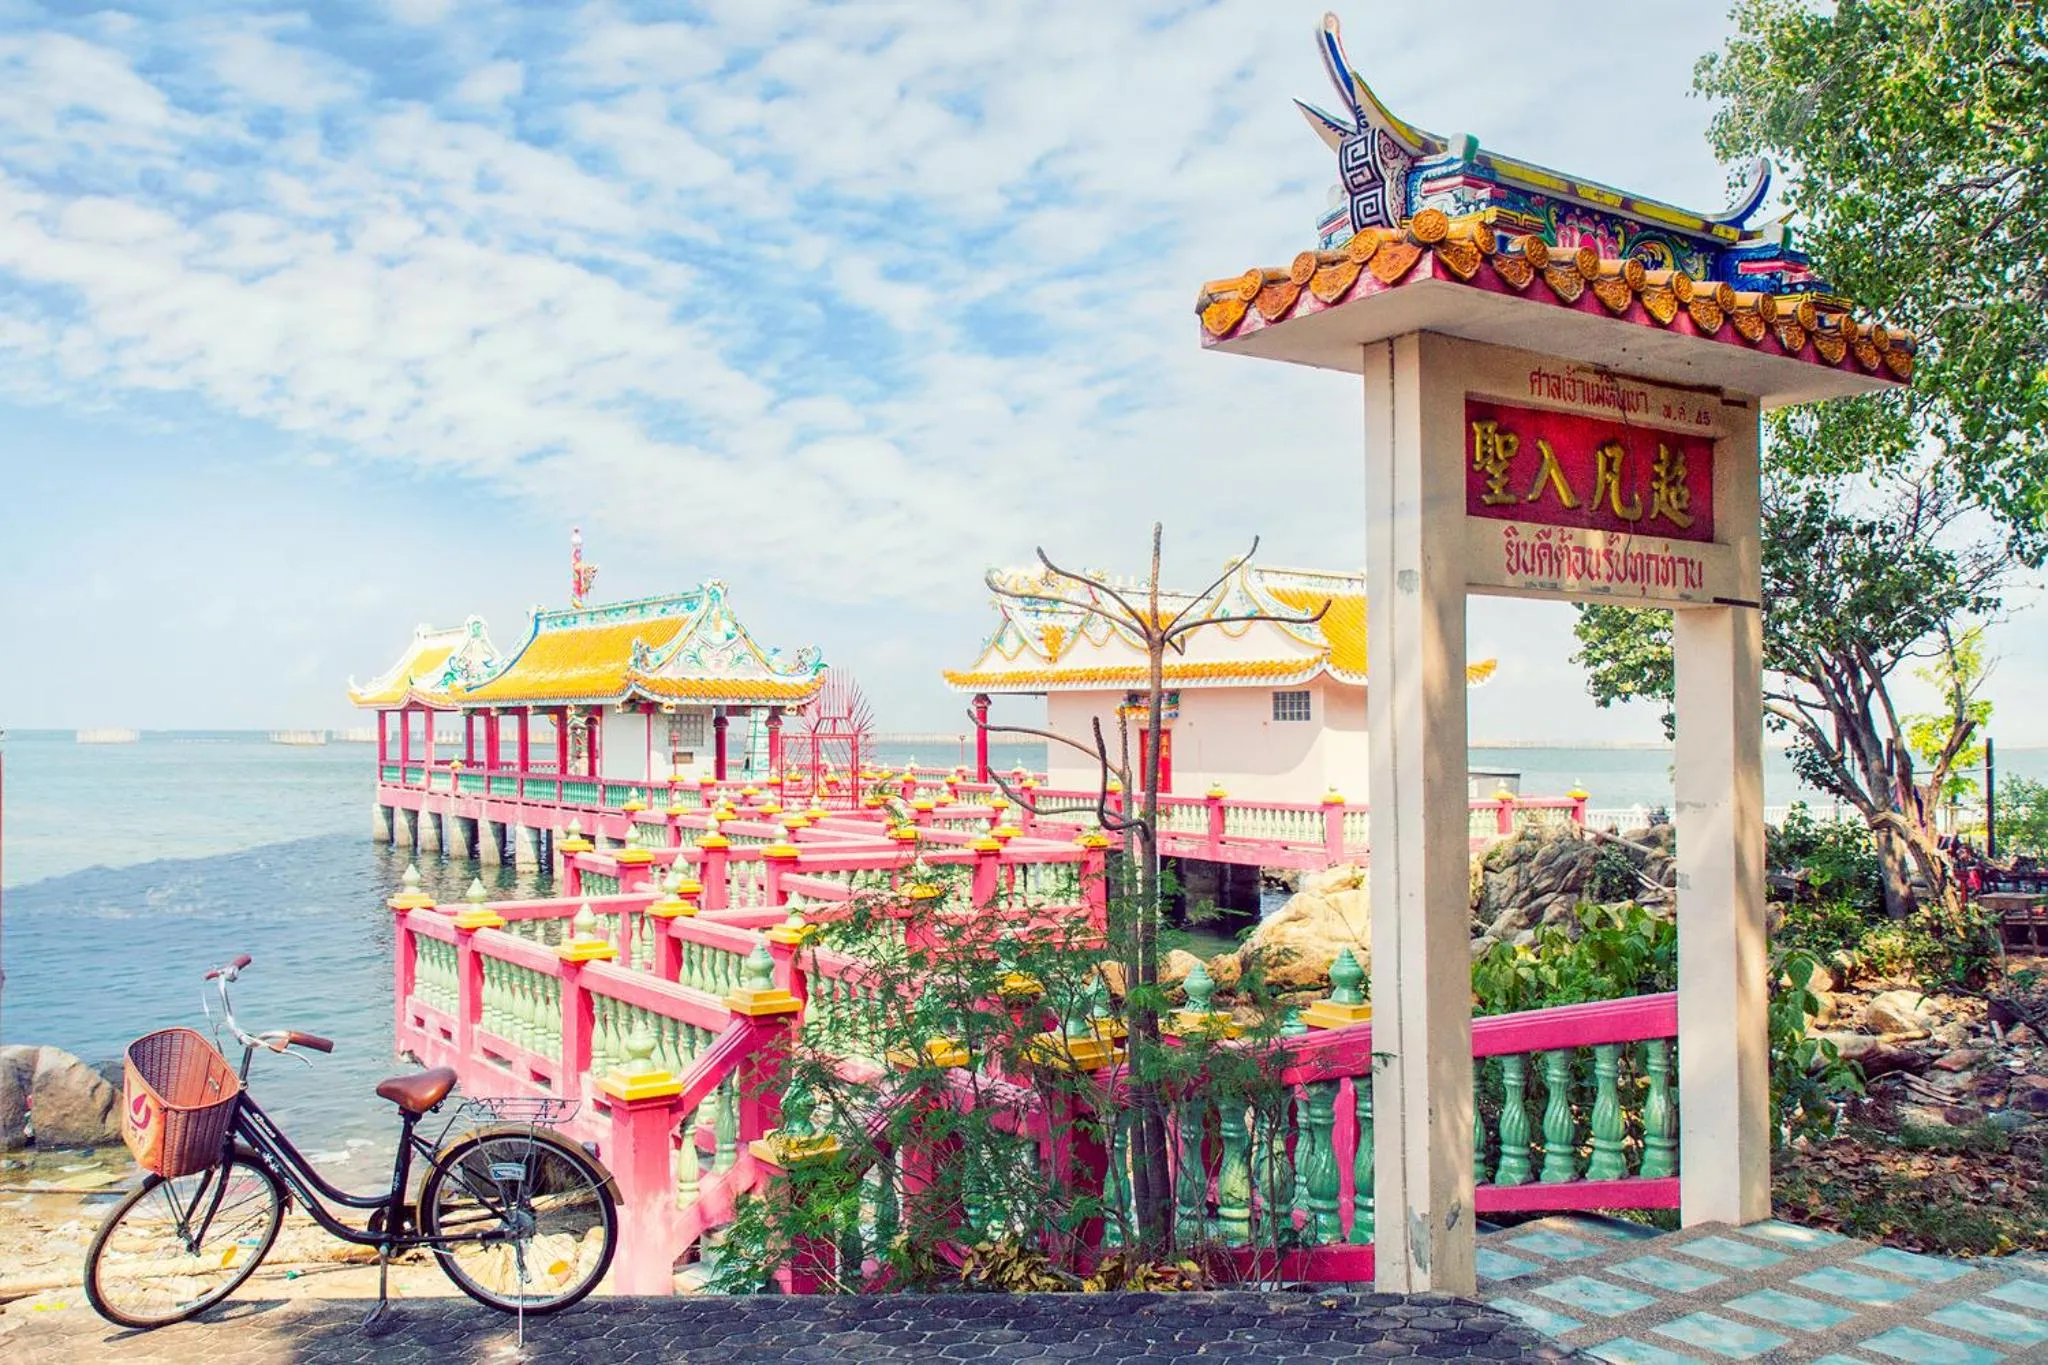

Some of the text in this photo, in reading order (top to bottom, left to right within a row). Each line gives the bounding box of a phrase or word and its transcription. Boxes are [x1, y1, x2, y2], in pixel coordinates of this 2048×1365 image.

[1504, 525, 1703, 595] ยินดีต้อนรับทุกท่าน
